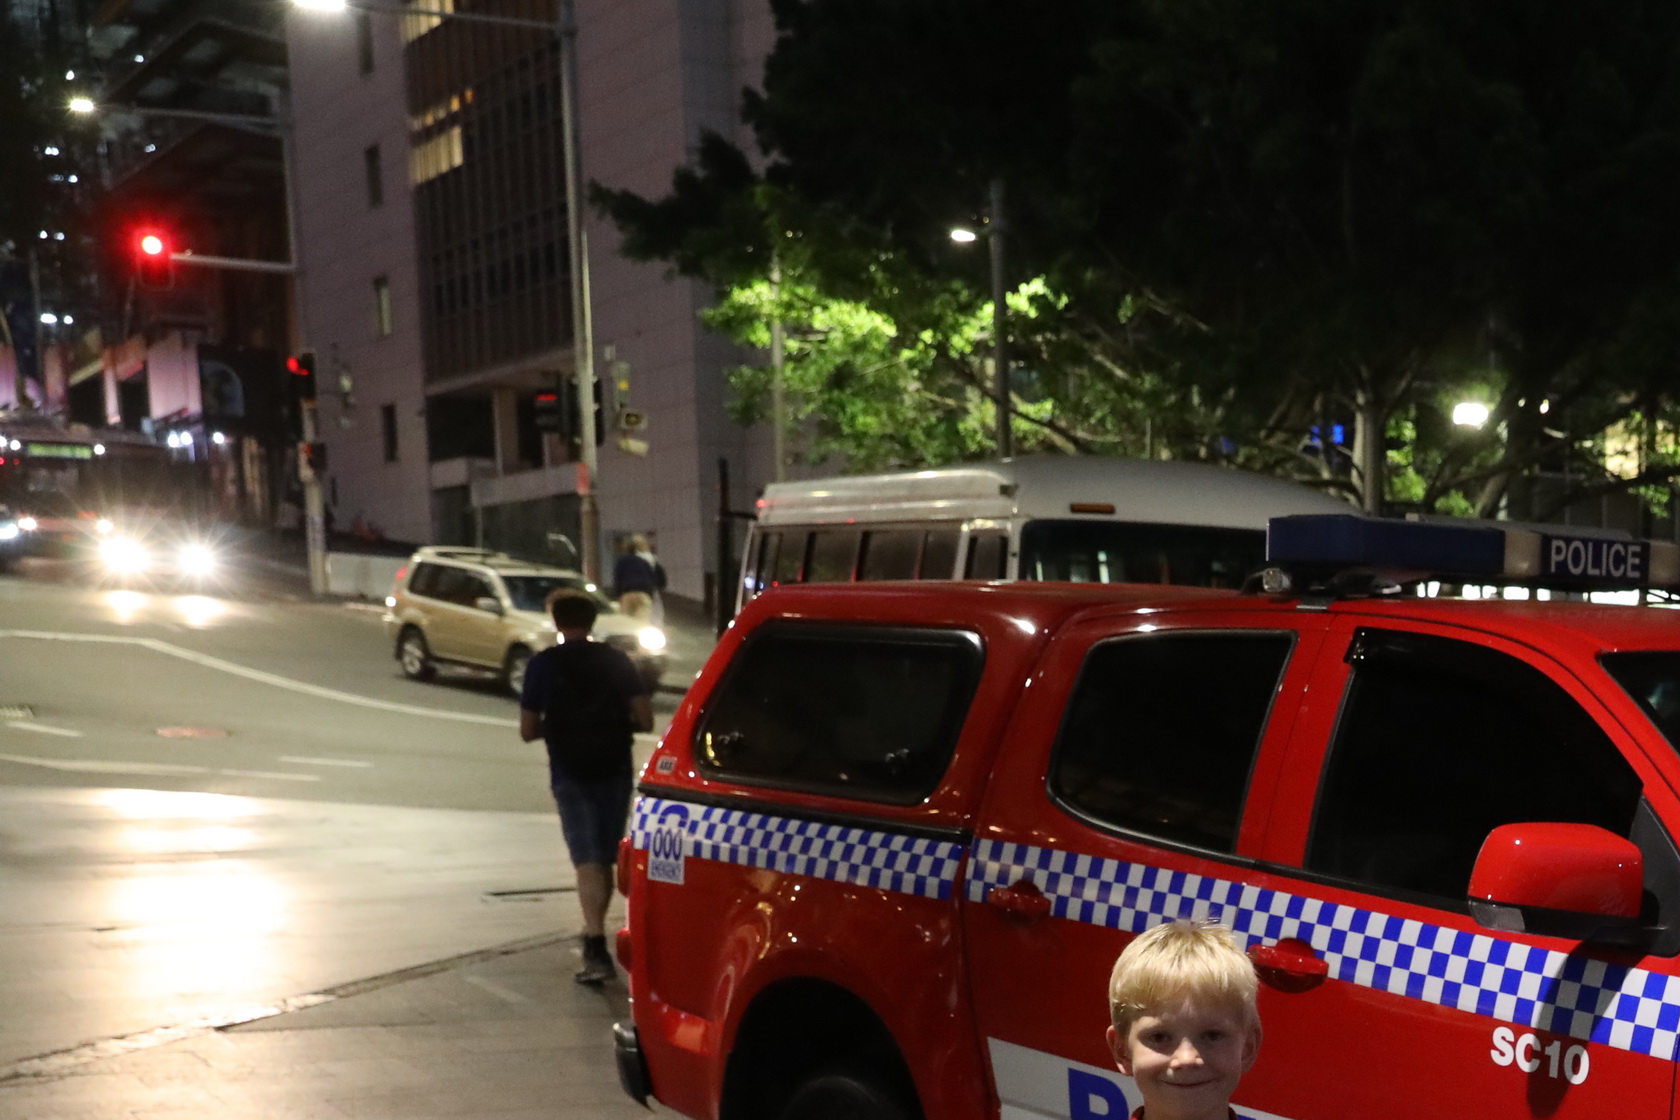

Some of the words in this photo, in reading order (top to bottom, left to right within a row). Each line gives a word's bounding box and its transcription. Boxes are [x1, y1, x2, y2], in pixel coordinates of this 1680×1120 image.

[1550, 539, 1641, 578] POLICE
[653, 827, 683, 861] 000
[1490, 1026, 1590, 1086] SC10
